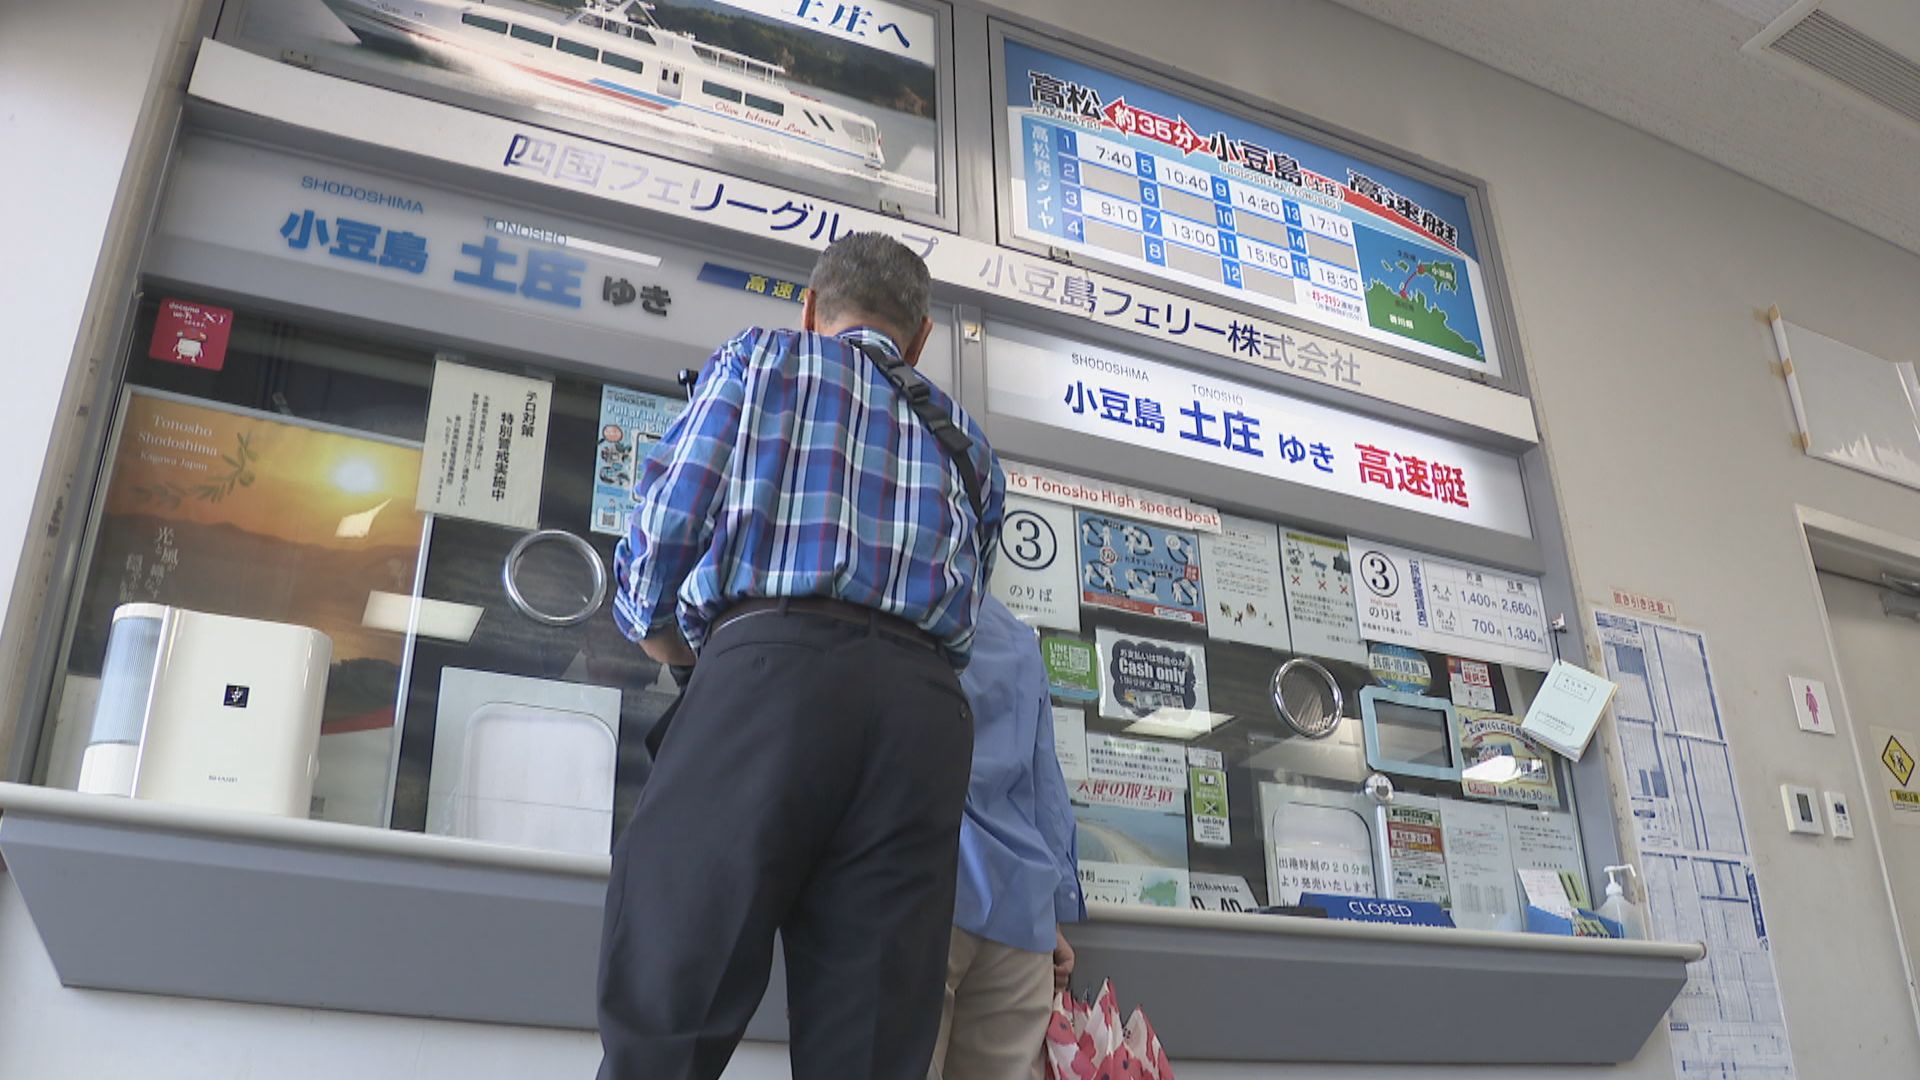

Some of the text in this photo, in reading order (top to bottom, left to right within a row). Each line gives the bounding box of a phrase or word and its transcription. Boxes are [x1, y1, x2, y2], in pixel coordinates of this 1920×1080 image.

[745, 111, 781, 127] Island
[1028, 70, 1103, 120] 高松
[1114, 105, 1194, 150] 約35分
[301, 175, 425, 215] SHODOSHIMA
[503, 133, 939, 259] 四国フェリーグルプ
[1031, 124, 1054, 229] 高松発ダイヤ
[1062, 135, 1349, 238] 1 7:40 5 10:40 9 14:20 13 17:10
[1063, 163, 1304, 249] 2 6 10 14
[483, 215, 568, 247] TONOSHO
[1066, 191, 1078, 206] 3
[1101, 201, 1137, 225] 9:10
[1143, 213, 1157, 230] 7
[1170, 222, 1215, 247] 13:00
[1221, 238, 1235, 254] 11
[1247, 245, 1288, 270] 15:50
[1319, 267, 1358, 292] 18:30
[1066, 221, 1240, 282] 4 8 12
[279, 208, 428, 274] 小豆島
[454, 235, 588, 309] 土庄
[603, 276, 671, 317] ゆき
[978, 254, 1362, 387] 小豆島フェリー株式会社
[1071, 352, 1149, 382] SHODOSHIMA
[521, 390, 537, 438] テロ対策
[1191, 383, 1244, 406] TONOSHO
[138, 431, 218, 457] Shodoshima
[152, 414, 214, 437] Tonosho
[1064, 380, 1469, 509] 小豆島 土庄 ゆき 高速艇
[139, 450, 209, 471] Kagawa Japan
[491, 412, 514, 502] 特別警戒実施中
[1009, 472, 1218, 526] To Tonosho High speed boat
[1009, 584, 1053, 602] のりば
[1369, 607, 1401, 622] のりば
[1118, 657, 1154, 679] Cash
[1157, 667, 1186, 686] only
[1281, 875, 1376, 895] より発売いたします。
[1348, 901, 1412, 918] CLOSED
